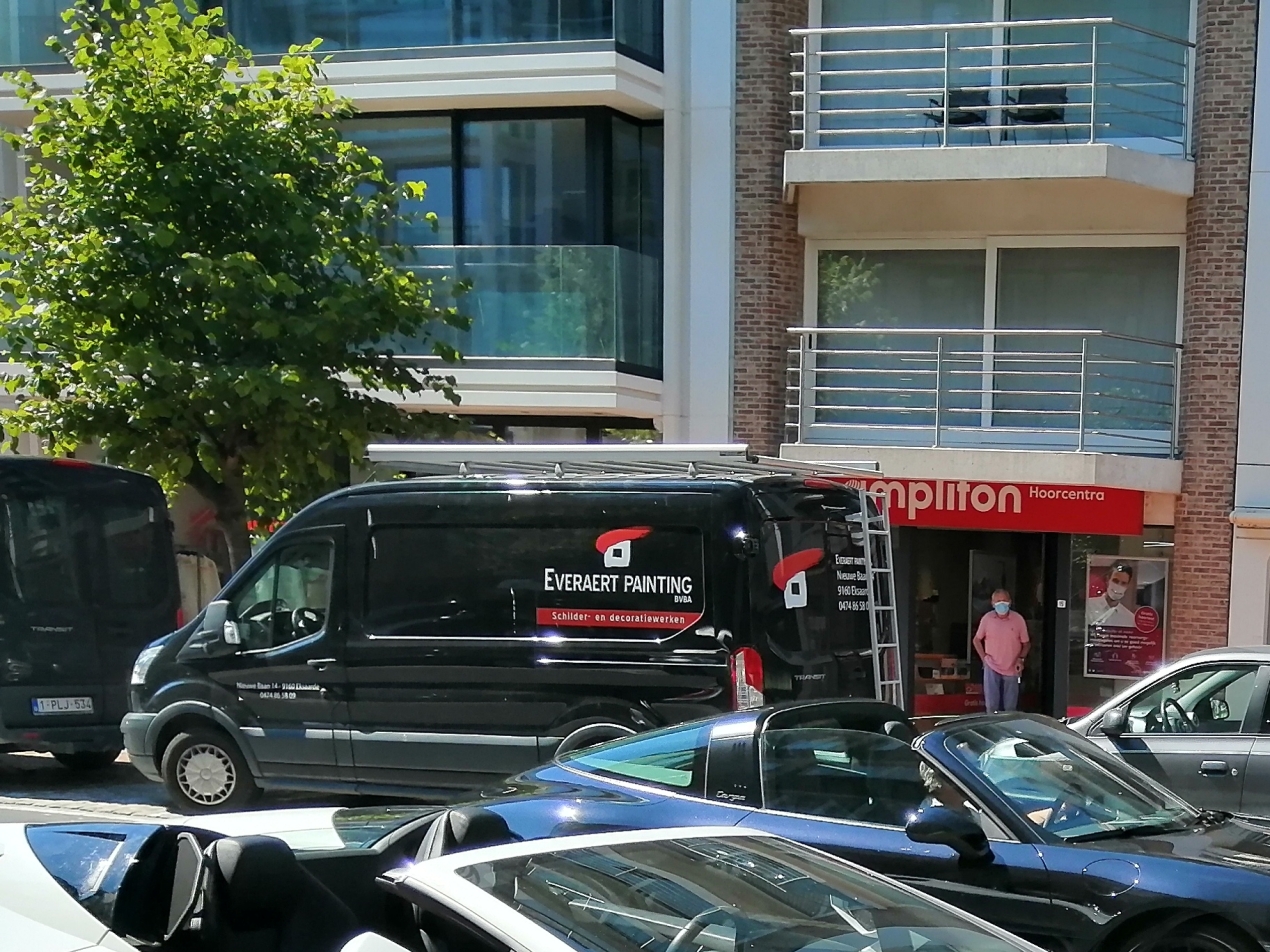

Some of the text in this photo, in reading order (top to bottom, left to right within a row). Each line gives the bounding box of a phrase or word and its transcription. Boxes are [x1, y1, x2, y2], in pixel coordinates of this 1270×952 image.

[1029, 485, 1105, 501] Hoorcentra
[544, 568, 693, 594] EVERAERT PAINTING
[838, 585, 851, 596] 9160
[674, 595, 693, 604] BVBA
[838, 600, 852, 611] 0474
[852, 600, 859, 611] 86
[551, 611, 685, 624] Schilder- en decoratiewerken
